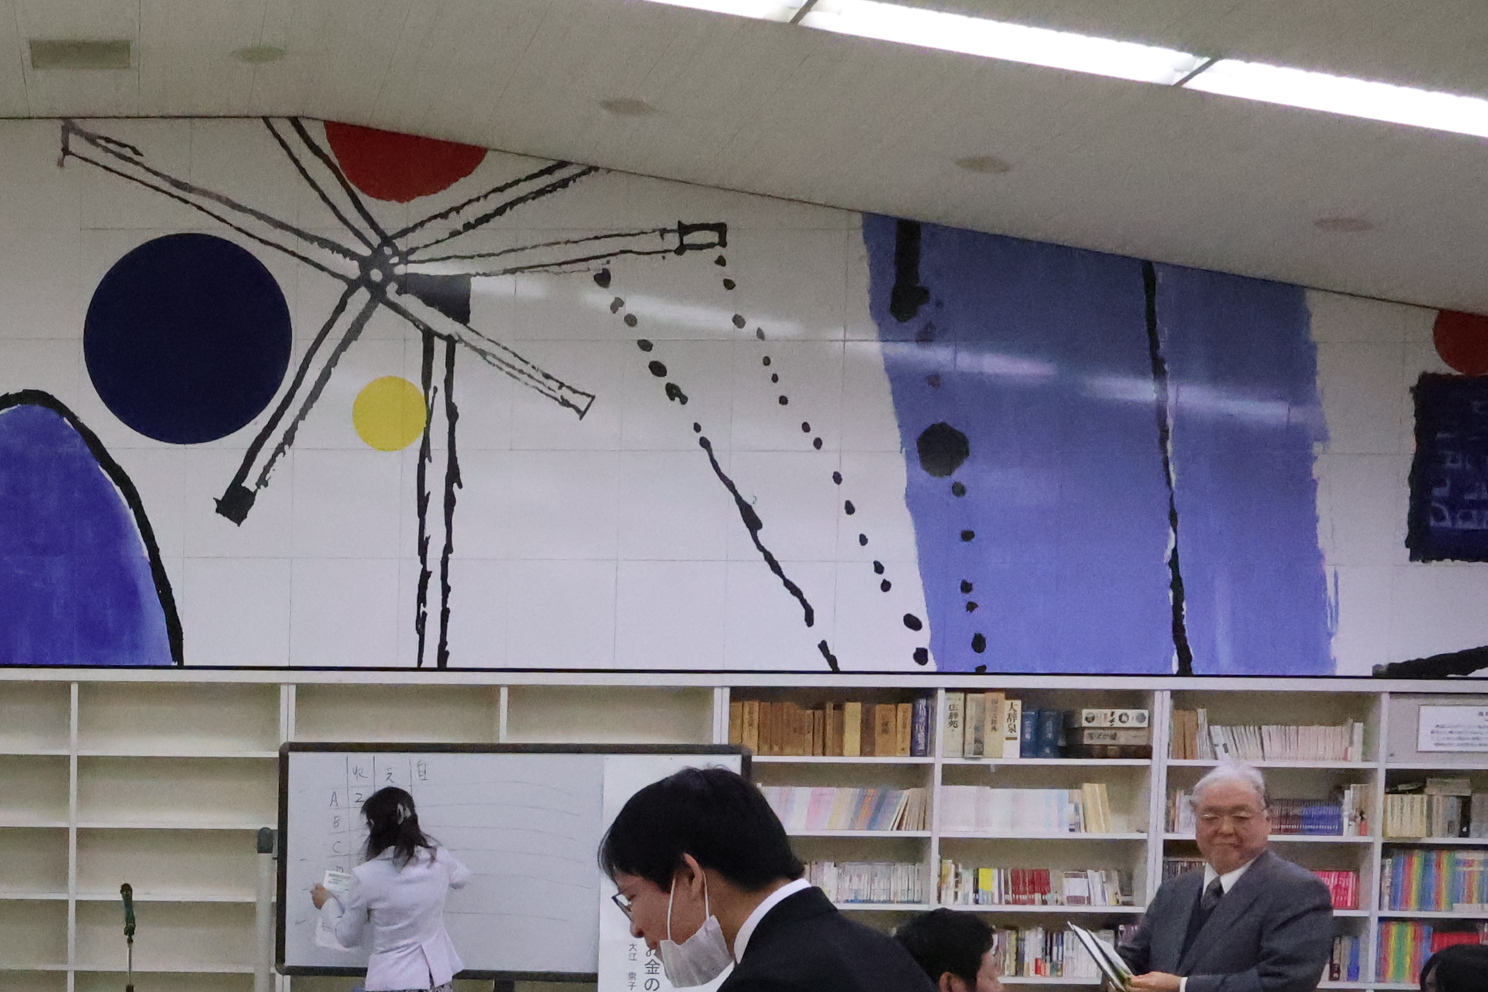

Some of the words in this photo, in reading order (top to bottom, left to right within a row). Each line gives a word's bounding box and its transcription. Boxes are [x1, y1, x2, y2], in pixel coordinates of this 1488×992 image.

[329, 791, 339, 807] A
[332, 815, 341, 829] B
[332, 841, 341, 853] C
[628, 943, 638, 962] 大江
